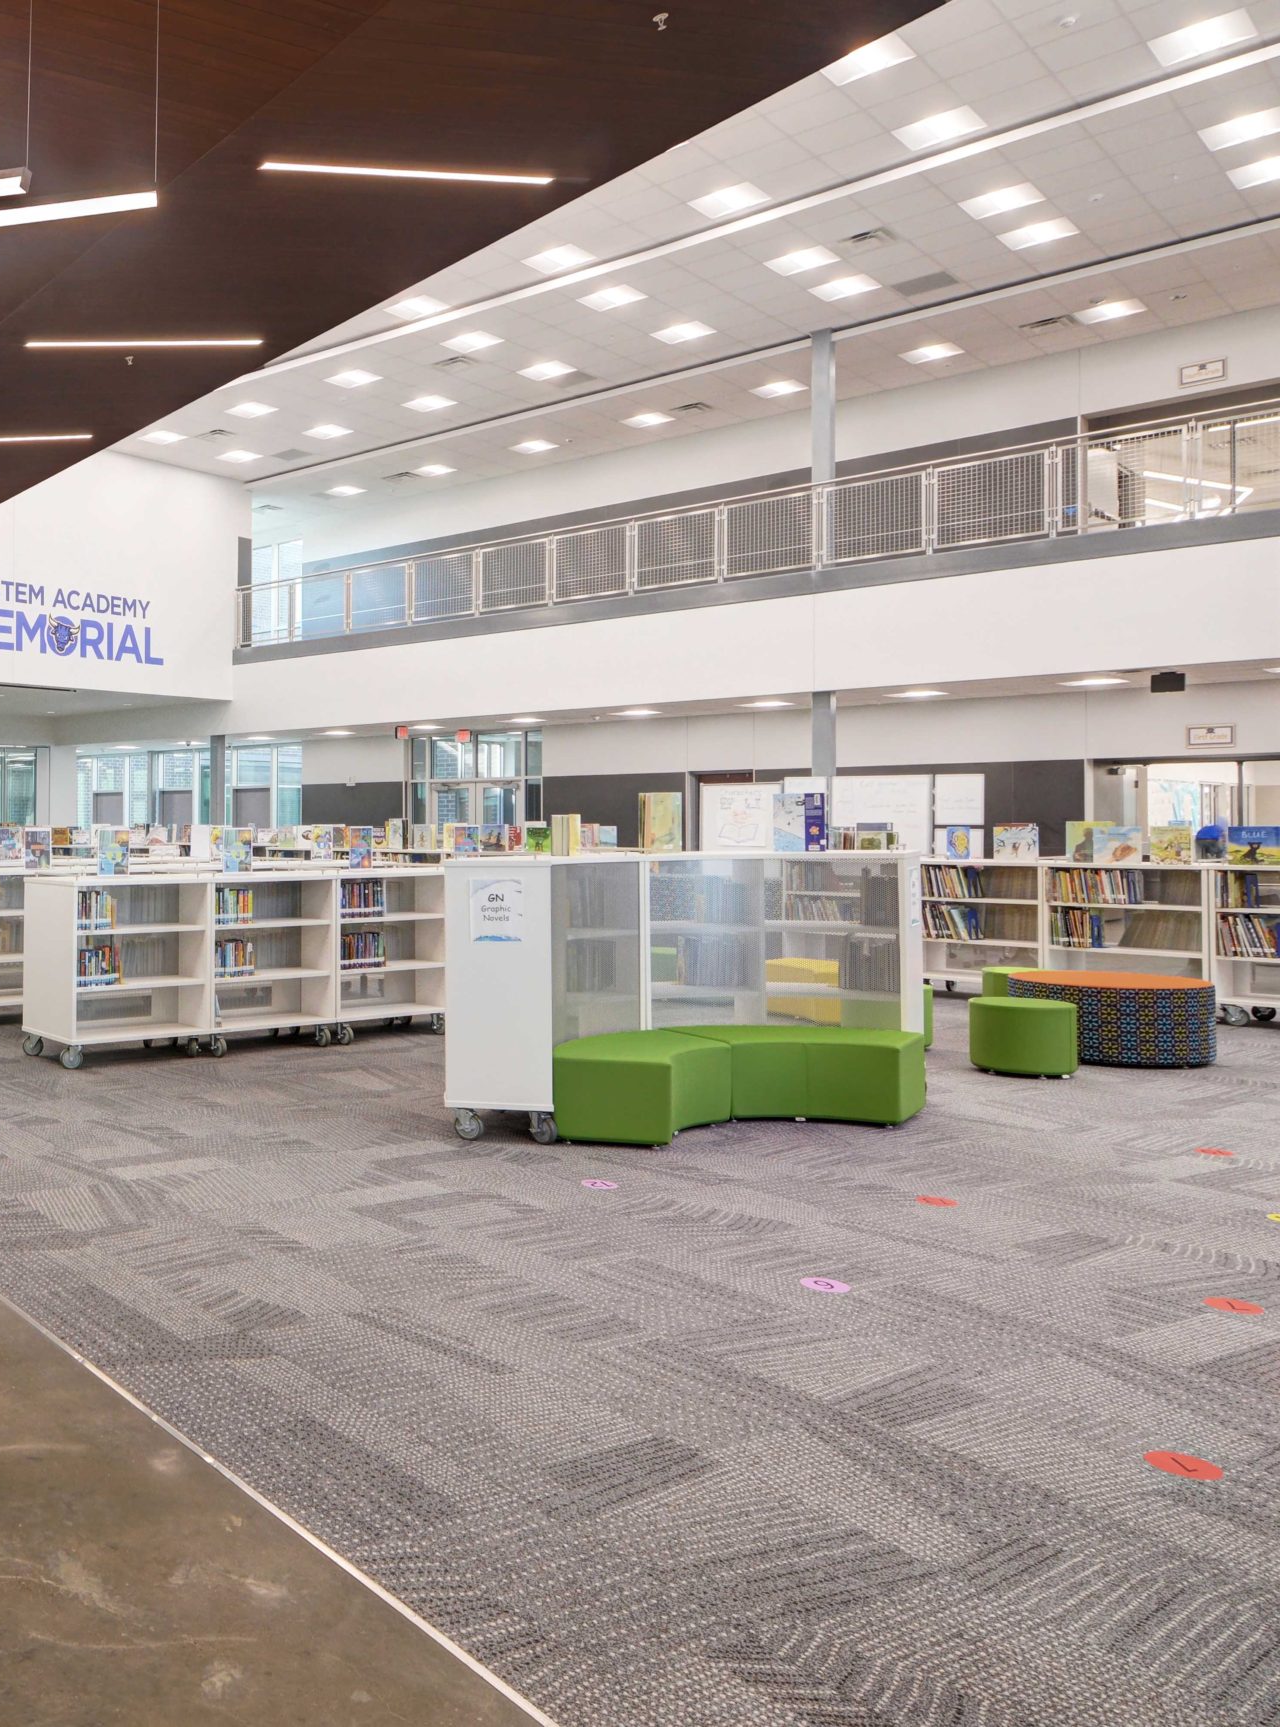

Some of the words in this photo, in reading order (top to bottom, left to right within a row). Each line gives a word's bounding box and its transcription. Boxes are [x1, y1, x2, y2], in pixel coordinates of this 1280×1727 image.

[53, 588, 150, 619] ACADEMY
[1241, 830, 1269, 839] BLUE
[488, 893, 504, 902] GN
[481, 904, 511, 913] Graphic
